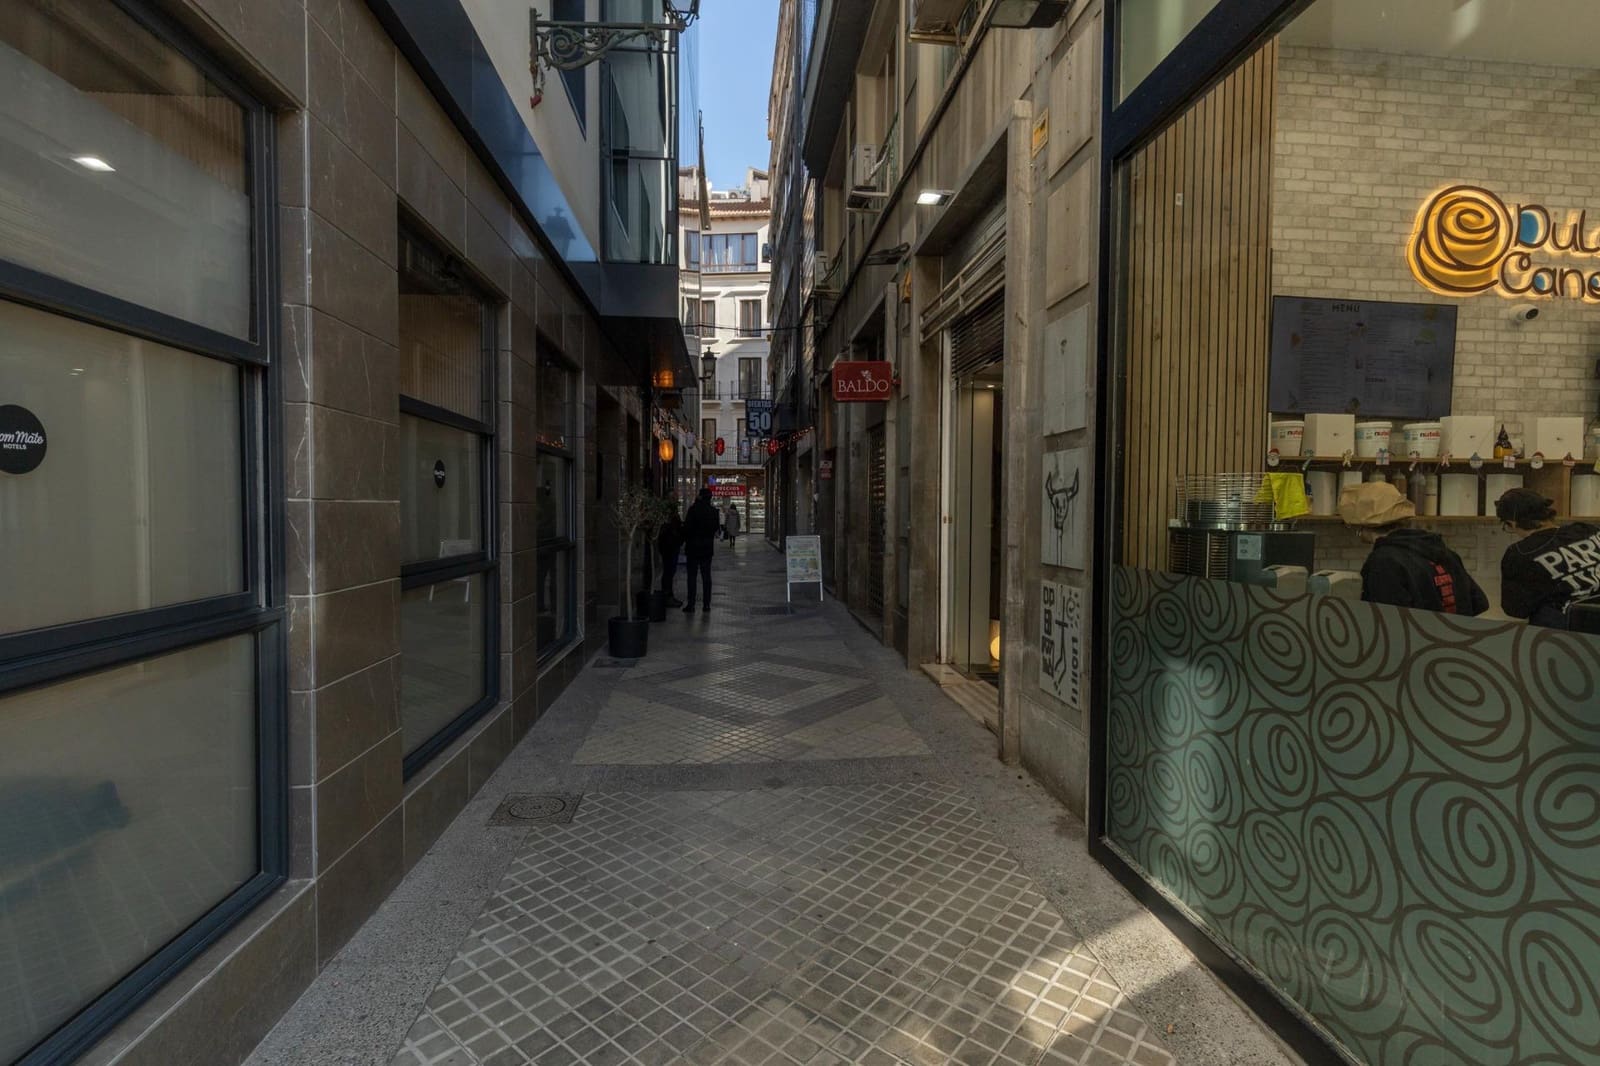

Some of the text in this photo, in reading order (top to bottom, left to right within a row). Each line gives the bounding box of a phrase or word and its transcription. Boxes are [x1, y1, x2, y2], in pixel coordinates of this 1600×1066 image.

[837, 379, 889, 393] BALDO
[749, 412, 772, 430] 50
[15, 431, 44, 444] Mate
